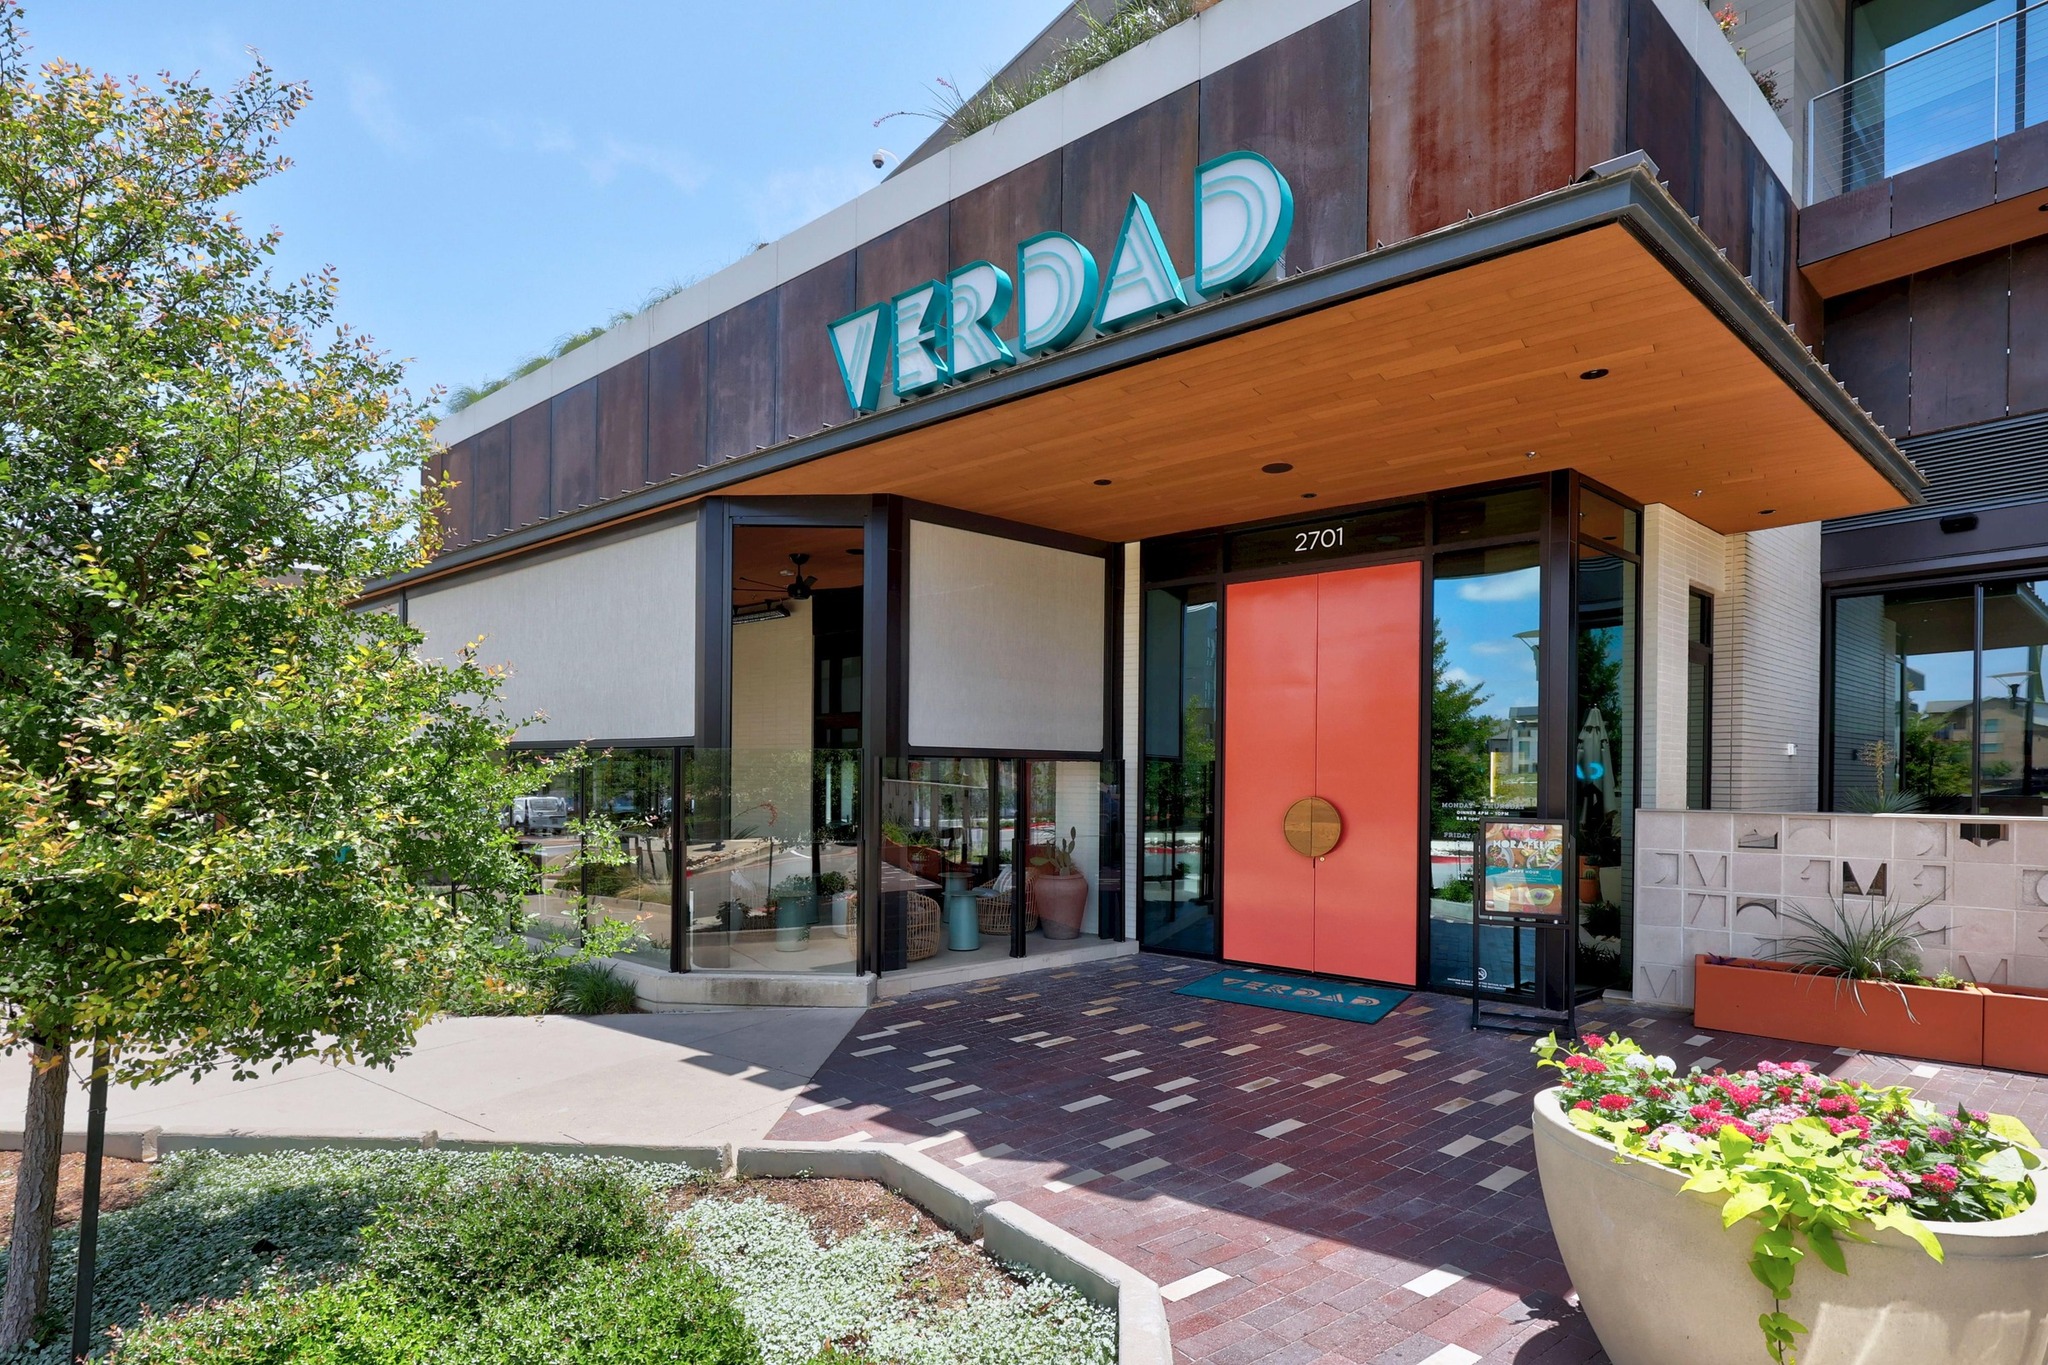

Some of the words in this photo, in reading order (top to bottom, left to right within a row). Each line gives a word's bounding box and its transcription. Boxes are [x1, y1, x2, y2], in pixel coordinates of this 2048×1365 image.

[827, 150, 1294, 412] VERDAD
[1294, 526, 1344, 552] 2701
[1483, 802, 1525, 810] THURSDAY
[1222, 977, 1382, 1007] VERDAD
